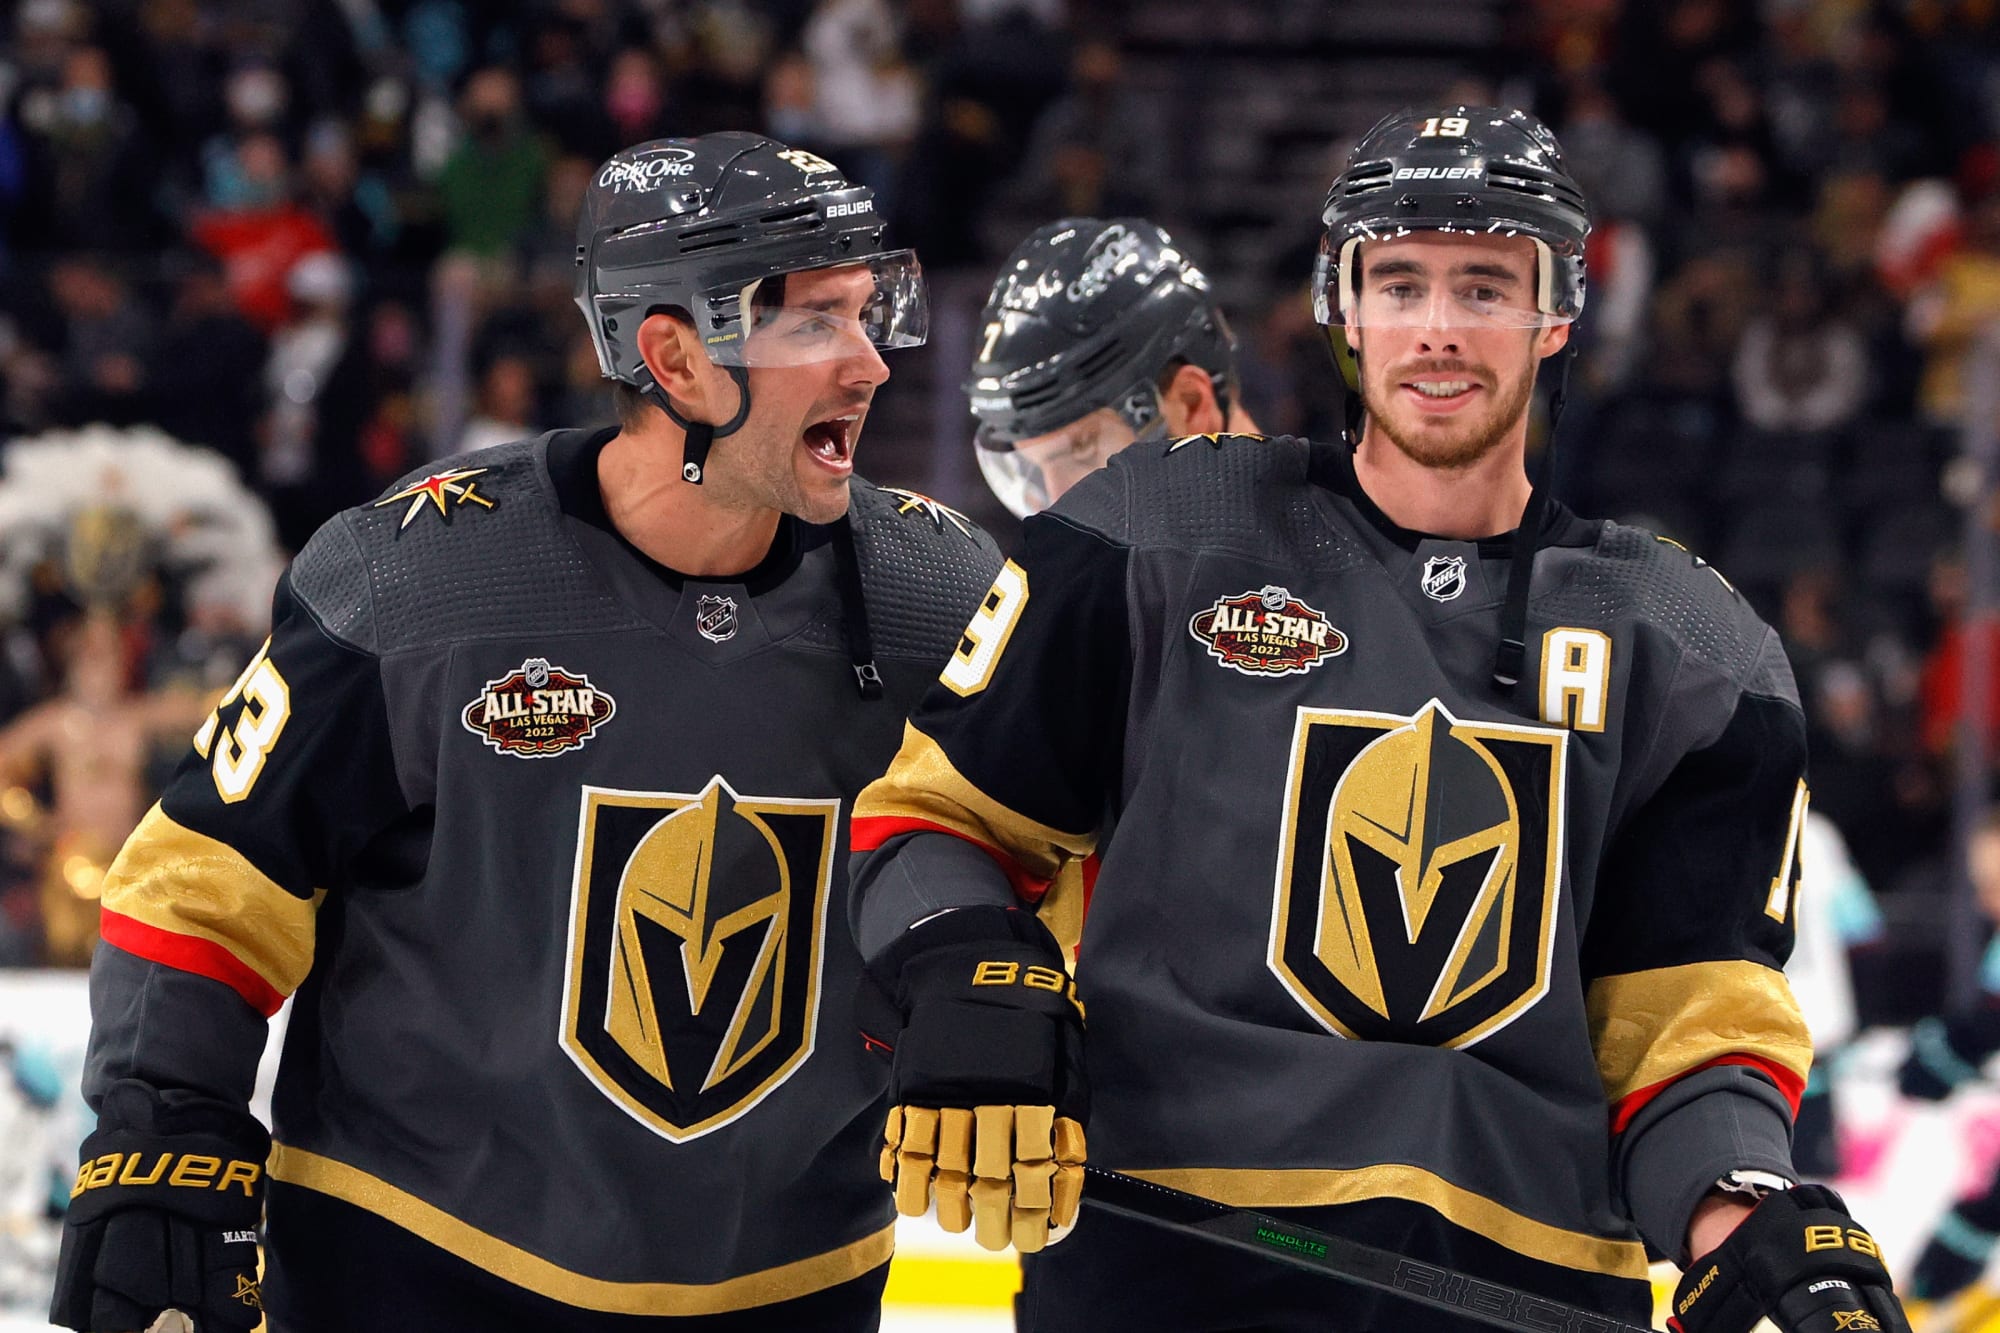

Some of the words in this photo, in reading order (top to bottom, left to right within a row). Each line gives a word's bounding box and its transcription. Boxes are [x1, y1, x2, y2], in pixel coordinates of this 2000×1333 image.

[1420, 117, 1469, 138] 19
[1395, 167, 1483, 180] BAUER
[826, 200, 873, 218] BAUER
[707, 333, 738, 344] BAUER
[979, 322, 1002, 363] 7
[1431, 567, 1458, 591] NHL
[1208, 604, 1260, 634] ALL
[1262, 612, 1328, 648] STAR
[1236, 632, 1258, 643] LAS
[1261, 634, 1298, 649] VEGAS
[1250, 644, 1281, 656] 2022
[1538, 626, 1613, 733] A
[482, 691, 530, 725] ALL
[531, 688, 596, 717] STAR
[510, 715, 531, 728] LAS
[533, 714, 569, 725] VEGAS
[525, 727, 555, 738] 2022
[1763, 776, 1811, 933] 1
[69, 1152, 261, 1200] BAUER
[1257, 1228, 1328, 1254] NANOLITE
[1393, 1258, 1652, 1333] RIBC
[1679, 1264, 1719, 1315] BAUER
[1808, 1280, 1851, 1294] SMITH
